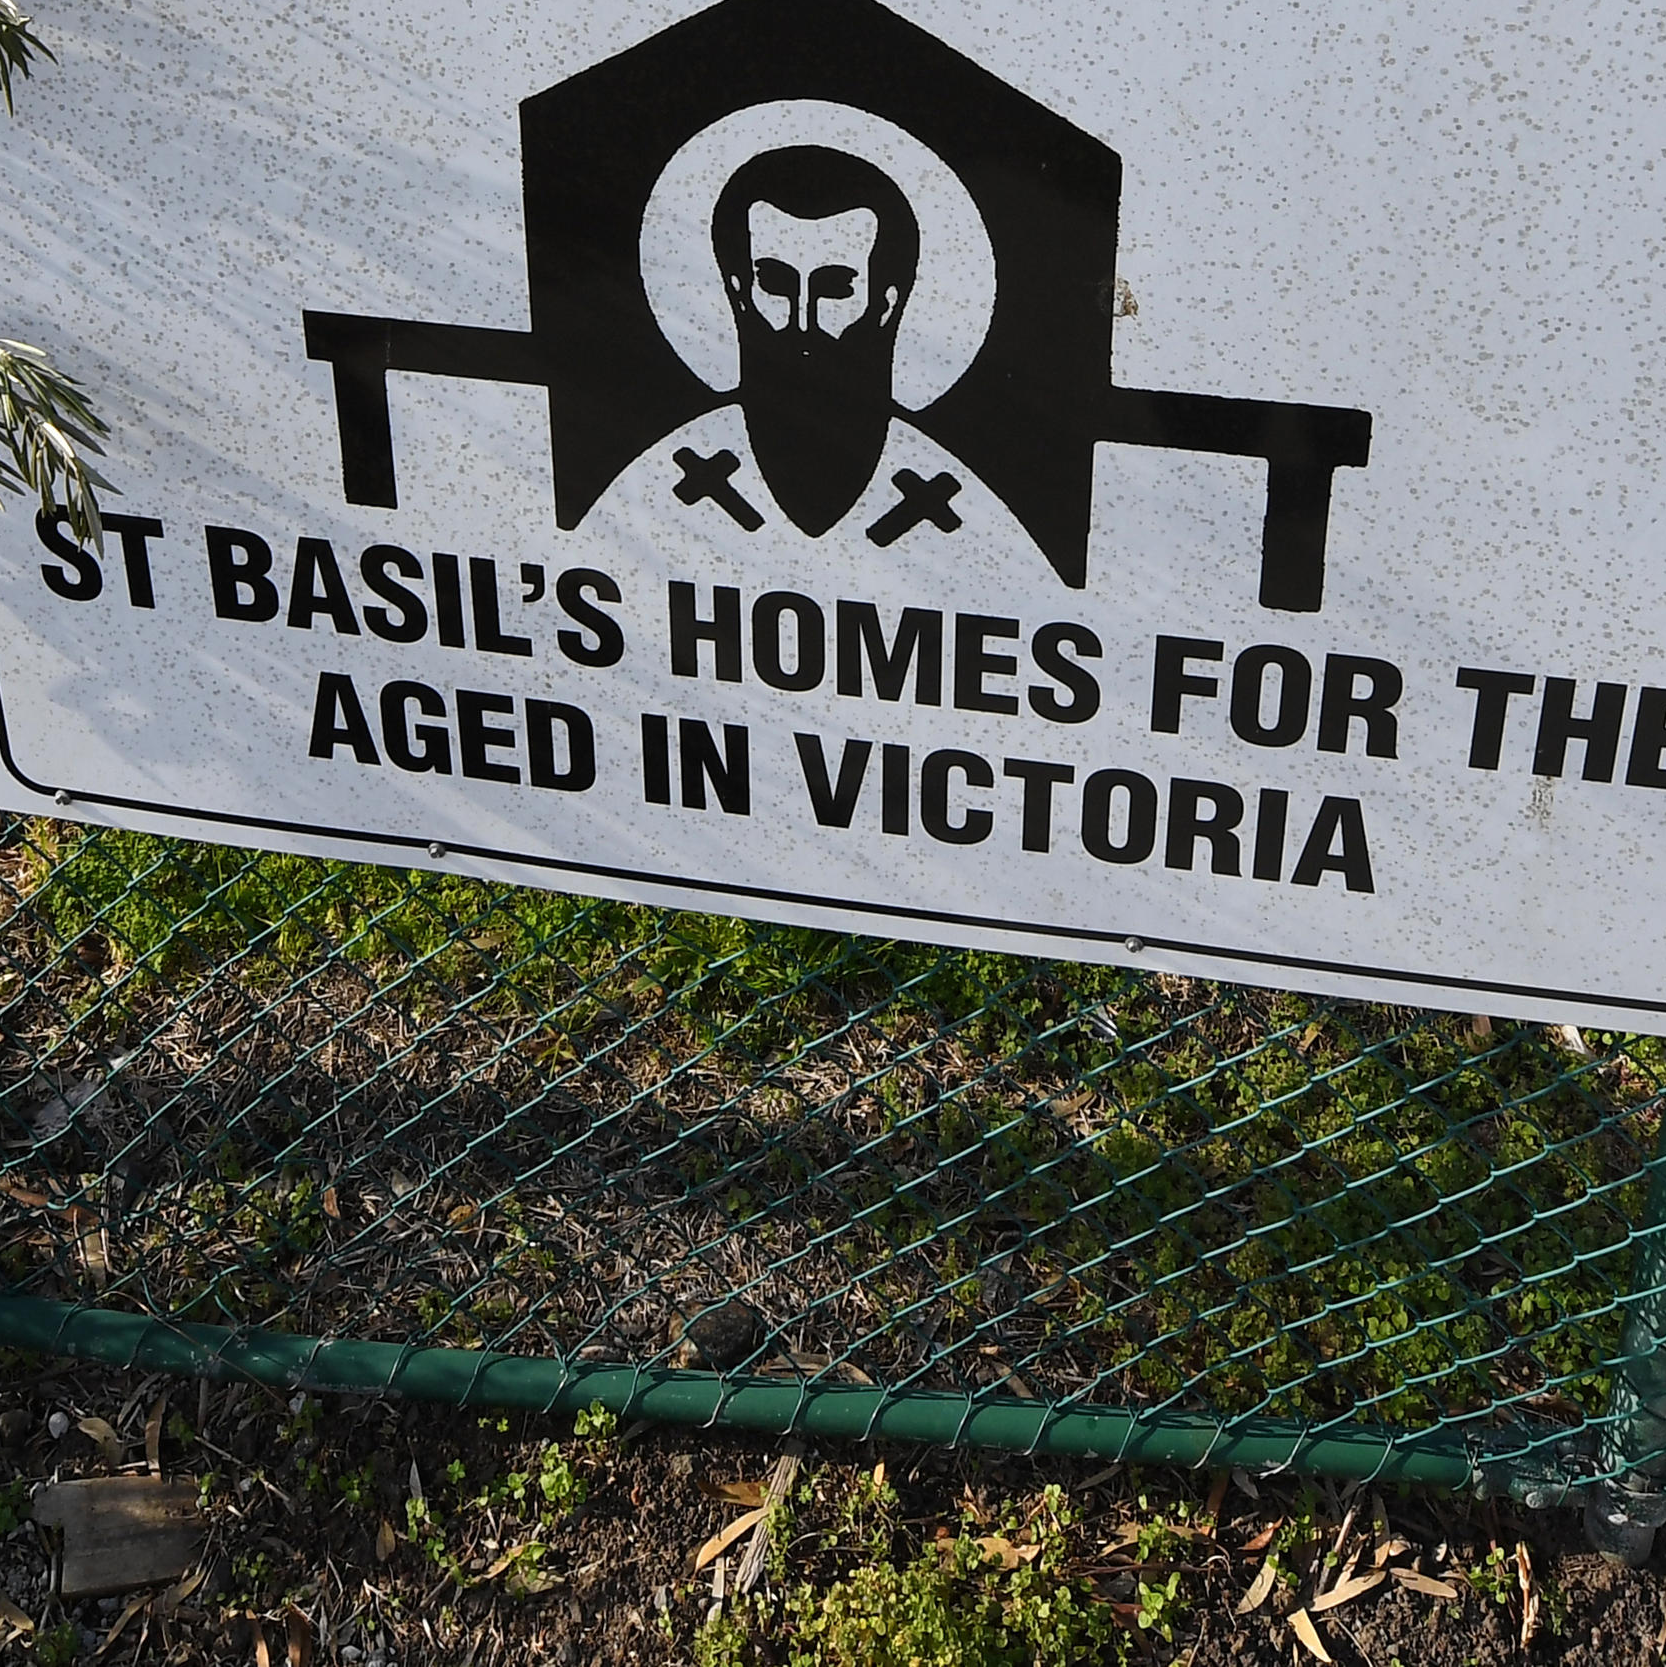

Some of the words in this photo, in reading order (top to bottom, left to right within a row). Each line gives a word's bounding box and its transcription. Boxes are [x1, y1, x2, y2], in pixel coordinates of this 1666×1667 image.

[34, 503, 165, 610] ST
[203, 524, 626, 669] BASIL'S
[667, 579, 1104, 725] HOMES
[1149, 633, 1404, 760] FOR
[308, 670, 597, 793] AGED
[640, 712, 752, 817] IN
[793, 731, 1376, 895] VICTORIA
